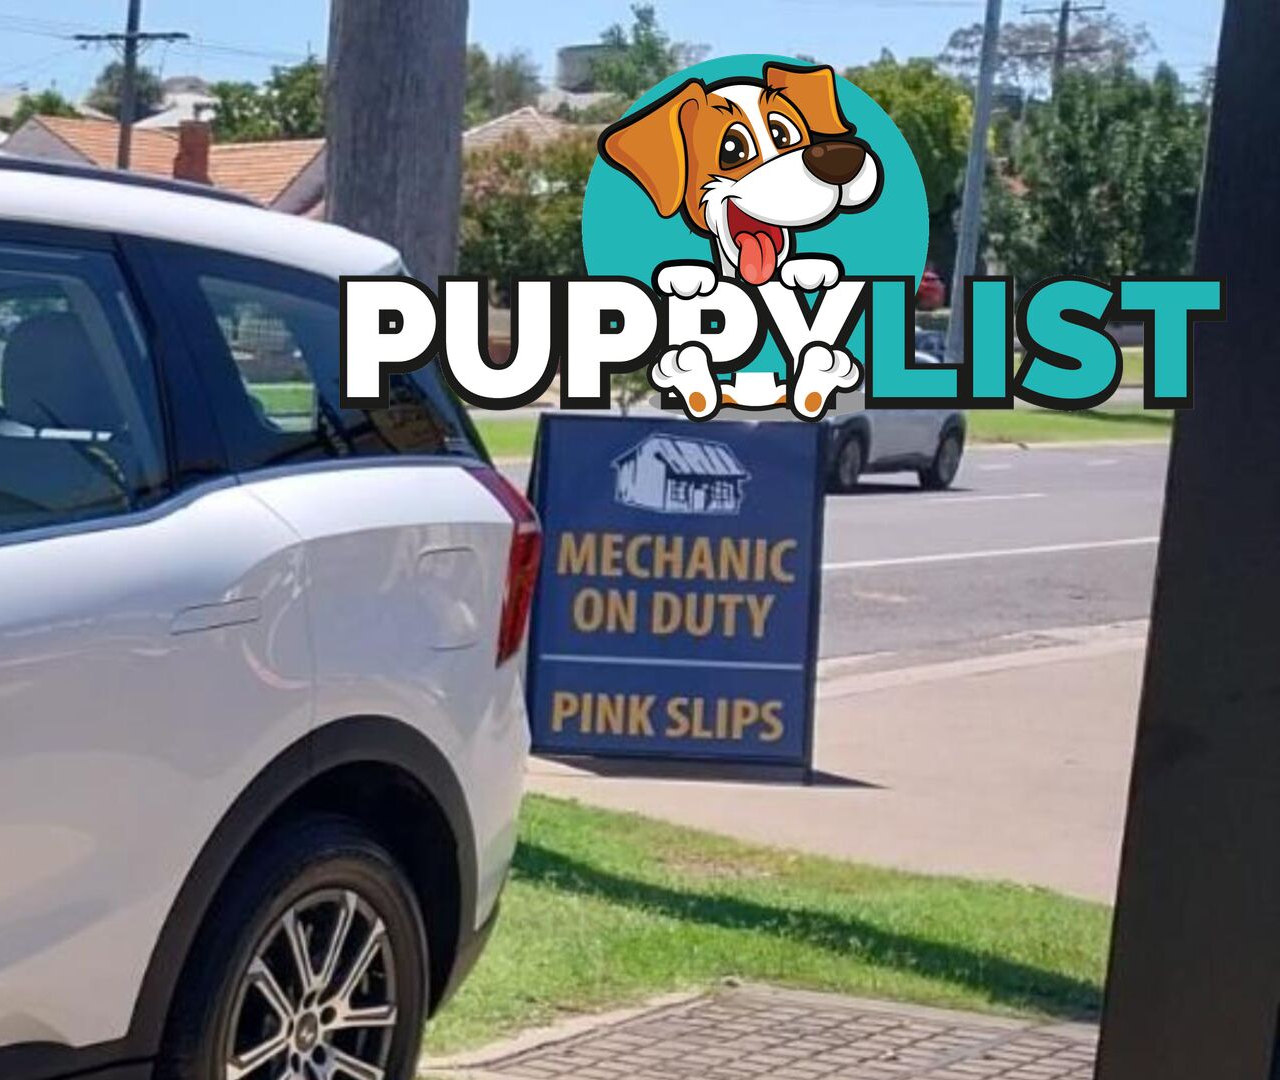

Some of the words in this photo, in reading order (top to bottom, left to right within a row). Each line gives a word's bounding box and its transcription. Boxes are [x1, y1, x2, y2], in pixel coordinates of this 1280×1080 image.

[556, 531, 798, 583] MECHANIC
[573, 586, 638, 634] ON
[651, 590, 776, 639] DUTY
[551, 691, 657, 737] PINK
[664, 696, 784, 742] SLIPS
